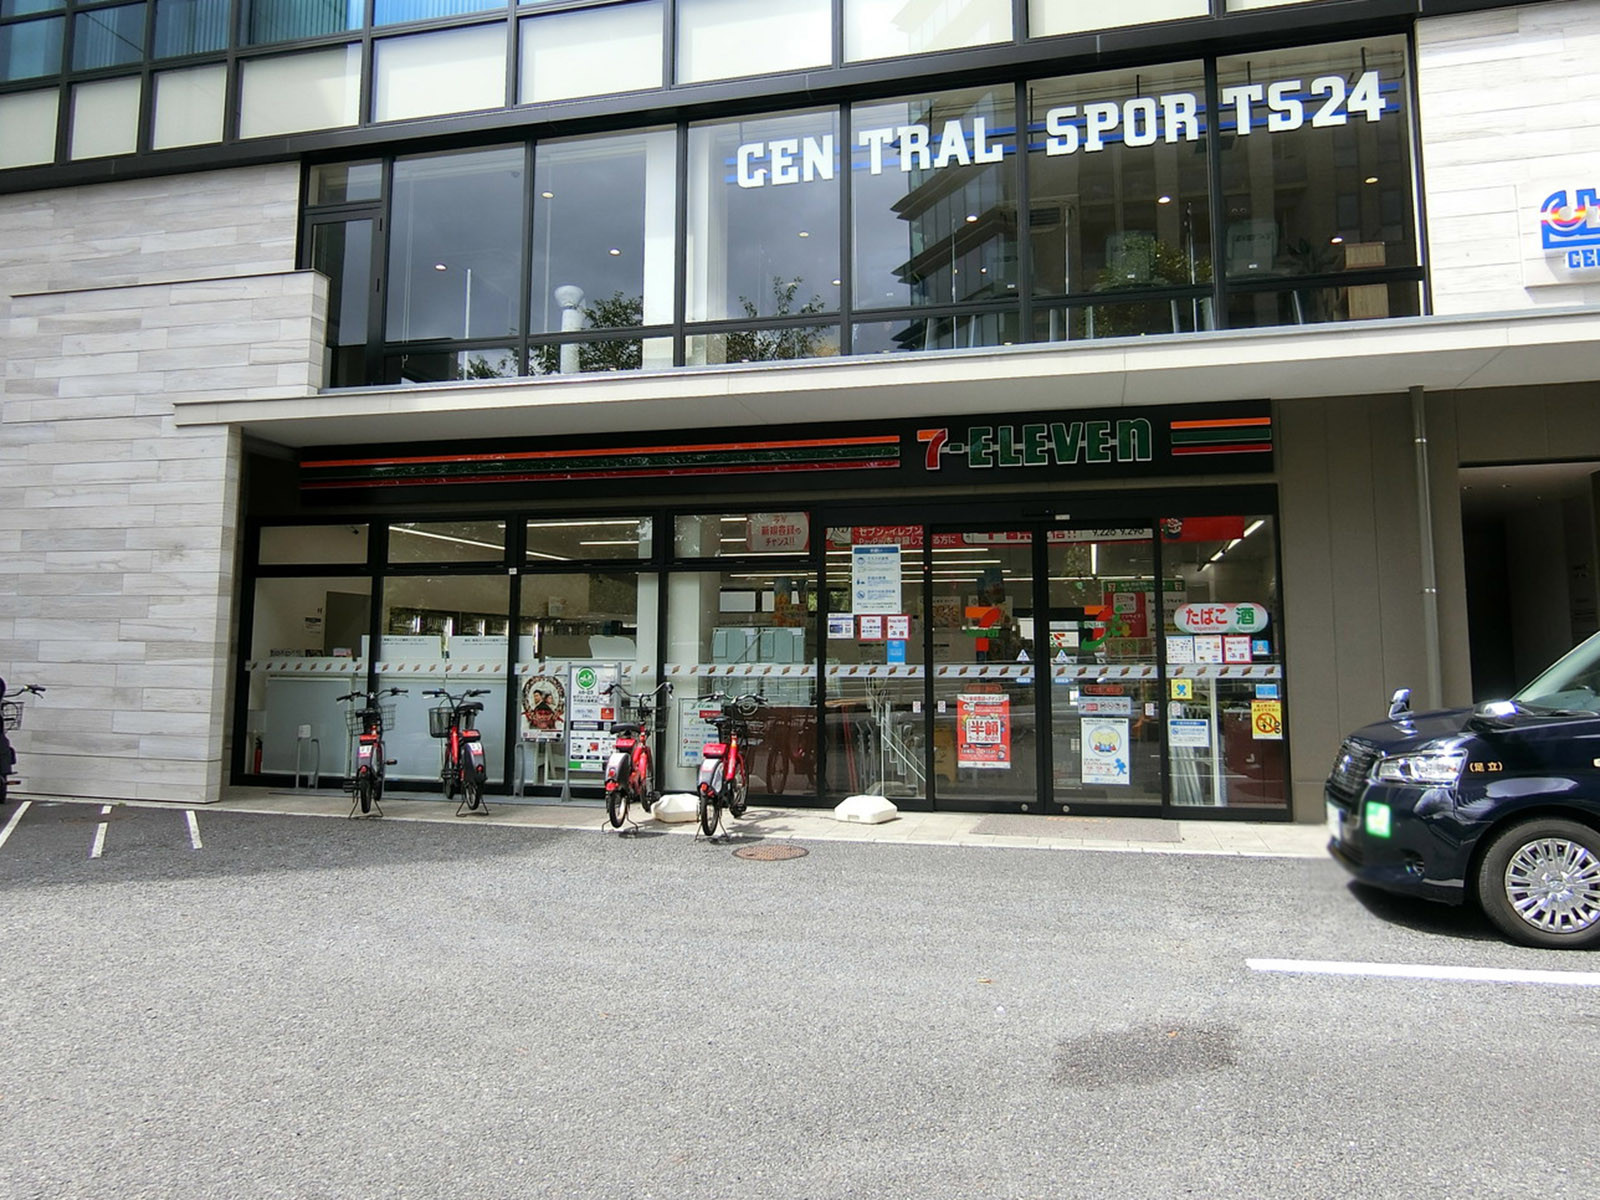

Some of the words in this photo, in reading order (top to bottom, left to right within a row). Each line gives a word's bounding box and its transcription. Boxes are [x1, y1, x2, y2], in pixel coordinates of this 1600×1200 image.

[1186, 608, 1228, 625] たばこ
[1236, 607, 1254, 625] 酒
